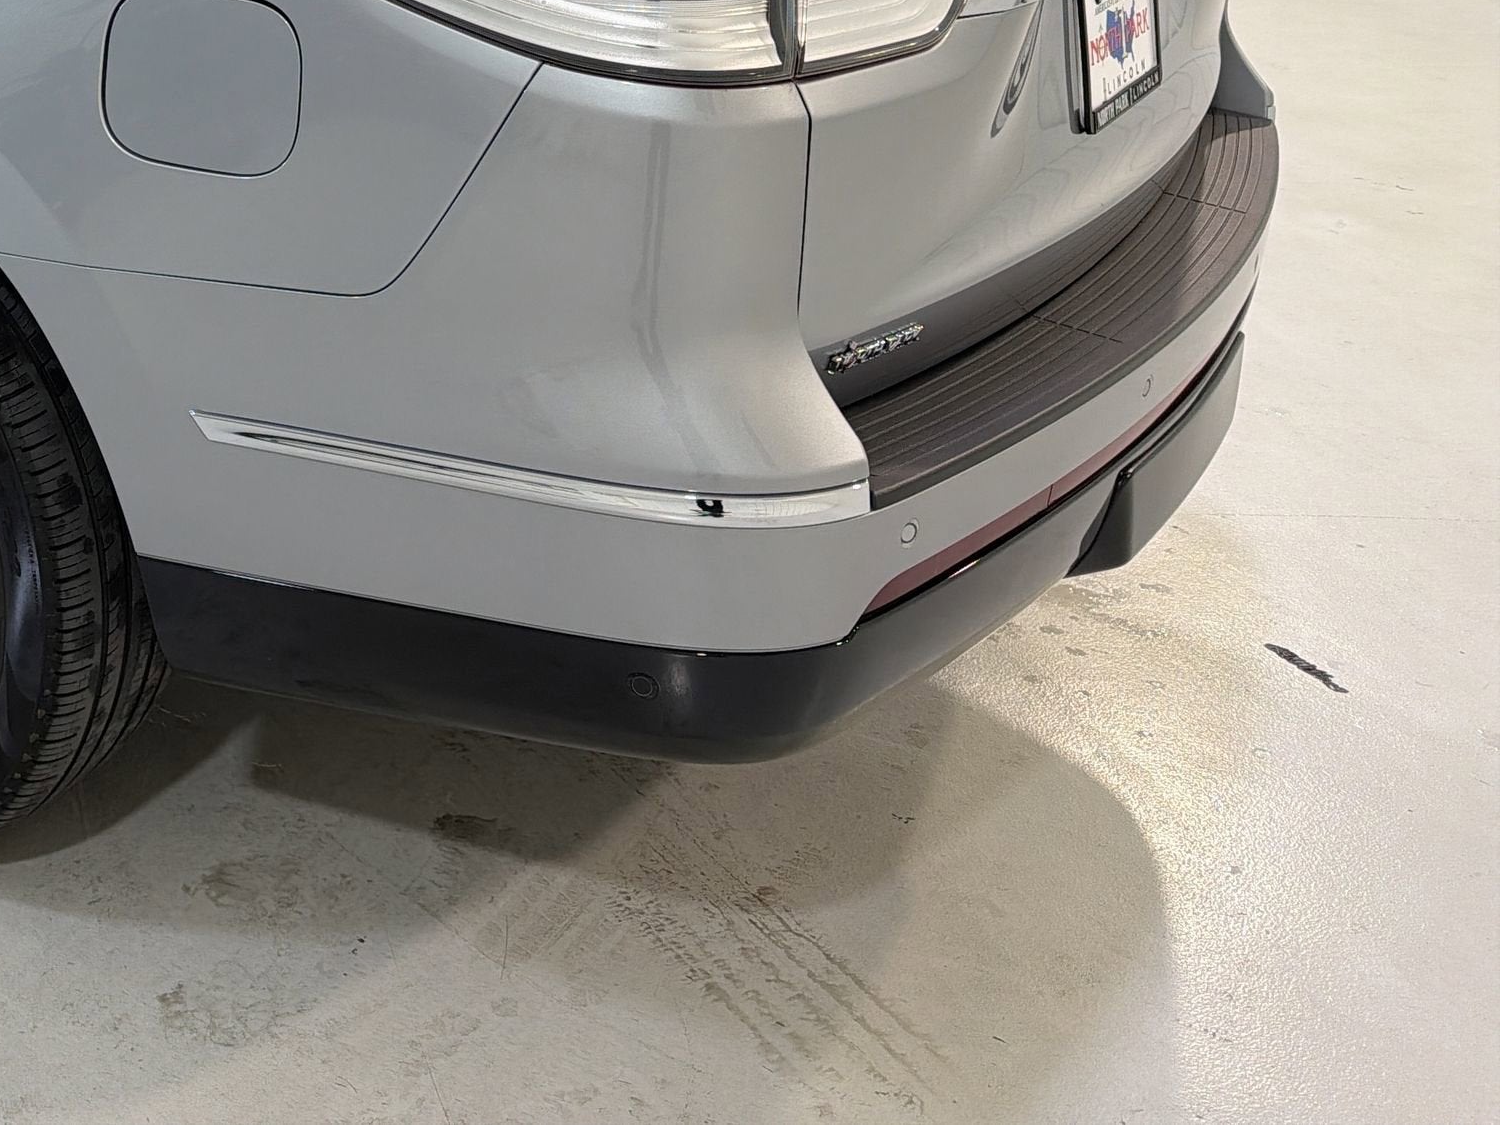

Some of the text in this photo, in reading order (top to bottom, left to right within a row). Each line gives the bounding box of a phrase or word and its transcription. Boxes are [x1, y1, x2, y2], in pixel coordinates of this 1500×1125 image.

[1089, 7, 1150, 66] NORTH PARK
[1107, 59, 1146, 94] LINCOLN
[1132, 70, 1159, 100] LINCOLN
